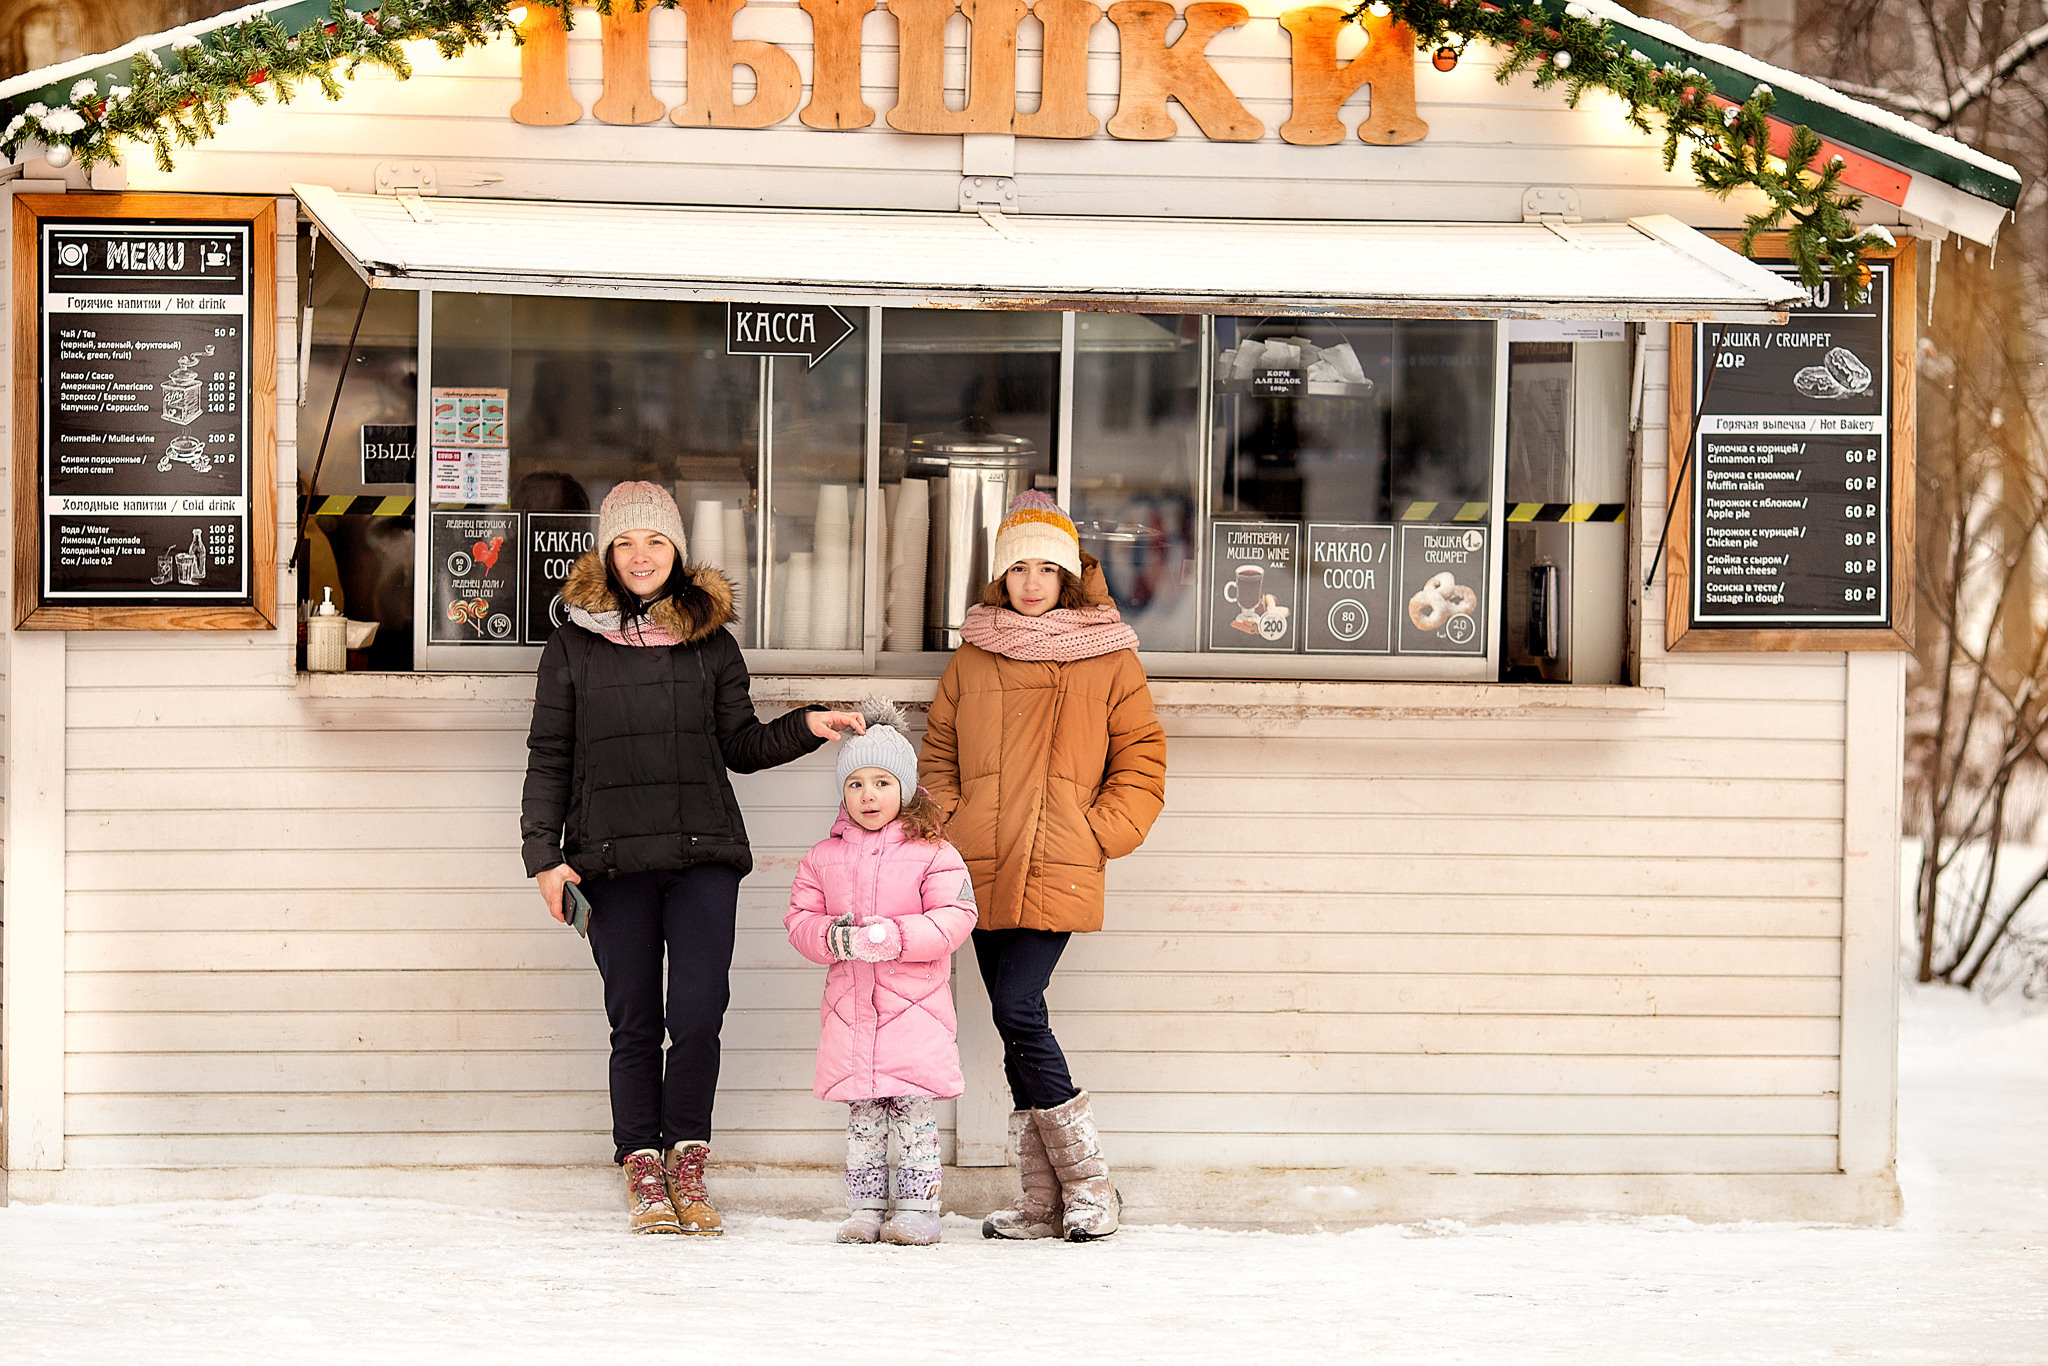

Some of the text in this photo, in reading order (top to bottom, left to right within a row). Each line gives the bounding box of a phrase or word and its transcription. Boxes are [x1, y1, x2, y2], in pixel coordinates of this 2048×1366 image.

[510, 0, 1430, 145] ПЫШКИ
[106, 241, 185, 271] MENU
[68, 297, 113, 310] Горячие
[117, 299, 161, 309] напитки
[177, 298, 194, 309] Hot
[199, 298, 226, 309] drink
[215, 328, 226, 337] 50
[736, 312, 816, 343] КАССА
[60, 330, 96, 338] Чай Tea
[1776, 333, 1831, 347] CRUMPET
[61, 340, 181, 351] (черный, зеленый, фруктовый)
[61, 351, 86, 360] (black,
[112, 351, 132, 361] fruit)
[91, 372, 114, 380] Cacao
[214, 372, 225, 381] 80
[61, 382, 153, 391] Американо Americano
[208, 383, 225, 391] 100
[61, 393, 136, 402] Эспрессо Espresso
[208, 393, 225, 402] 100
[61, 403, 149, 413] Капучино Cappuccino
[208, 404, 224, 412] 140
[1716, 418, 1759, 431] Горячая
[1763, 421, 1806, 430] выпечка
[1820, 419, 1836, 429] Hot
[1840, 419, 1874, 432] Bakery
[61, 434, 155, 443] Глинтвейн Mulled wine
[209, 434, 225, 443] 200
[1708, 443, 1798, 455] Булочка с корицей
[61, 455, 89, 463] Сливки
[214, 455, 225, 463] 20
[1708, 454, 1773, 463] Cinnamon roll
[1846, 450, 1862, 462] 60
[1707, 470, 1795, 482] Булочка с изюмом
[1707, 481, 1764, 490] Muffin raisin
[1846, 478, 1862, 490] 60
[62, 499, 119, 512] Холодные
[123, 501, 166, 510] напитки
[183, 499, 204, 511] Cold
[209, 500, 235, 511] drink
[1707, 498, 1751, 510] Пирожок
[1759, 498, 1801, 507] яблоком
[1706, 509, 1750, 520] Apple pie
[1845, 506, 1862, 518] 60
[209, 525, 226, 534] 100
[446, 520, 474, 529] ЛЕДЕНЕЦ
[476, 520, 506, 530] ПЕТУШОК
[61, 526, 109, 535] Вода Water
[1706, 527, 1752, 539] Пирожок
[1759, 527, 1799, 538] курицей
[61, 536, 140, 545] Лимонад Lemonade
[209, 536, 226, 544] 150
[534, 531, 595, 552] КАКАО
[1228, 532, 1282, 545] ГЛИНТВЕЙН
[1424, 535, 1462, 548] ПЫШКА
[1706, 538, 1758, 549] Chicken pie
[1845, 533, 1862, 545] 80
[61, 546, 100, 556] Холодный
[101, 546, 115, 554] чай
[209, 546, 226, 554] 150
[1227, 547, 1289, 560] MULLED WINE
[1315, 542, 1372, 563] КАКАО
[61, 557, 112, 566] Сок Juice 0,2
[214, 556, 226, 565] 80
[1425, 550, 1468, 563] CRUMPET
[1707, 554, 1741, 565] Слойка
[1750, 557, 1782, 566] сыром
[1707, 566, 1777, 575] Pie with cheese
[1845, 561, 1862, 573] 80
[1324, 569, 1375, 589] COCOA
[452, 580, 480, 589] ЛЕДЕНЕЦ
[482, 580, 499, 588] ЛОЛИ
[1706, 583, 1778, 594] Сосиска в тесте
[1706, 593, 1784, 604] Sausage in dough
[1845, 589, 1862, 601] 80
[1342, 612, 1355, 621] 80
[493, 619, 506, 628] 150
[1264, 620, 1283, 633] 200
[1453, 620, 1467, 630] 20
